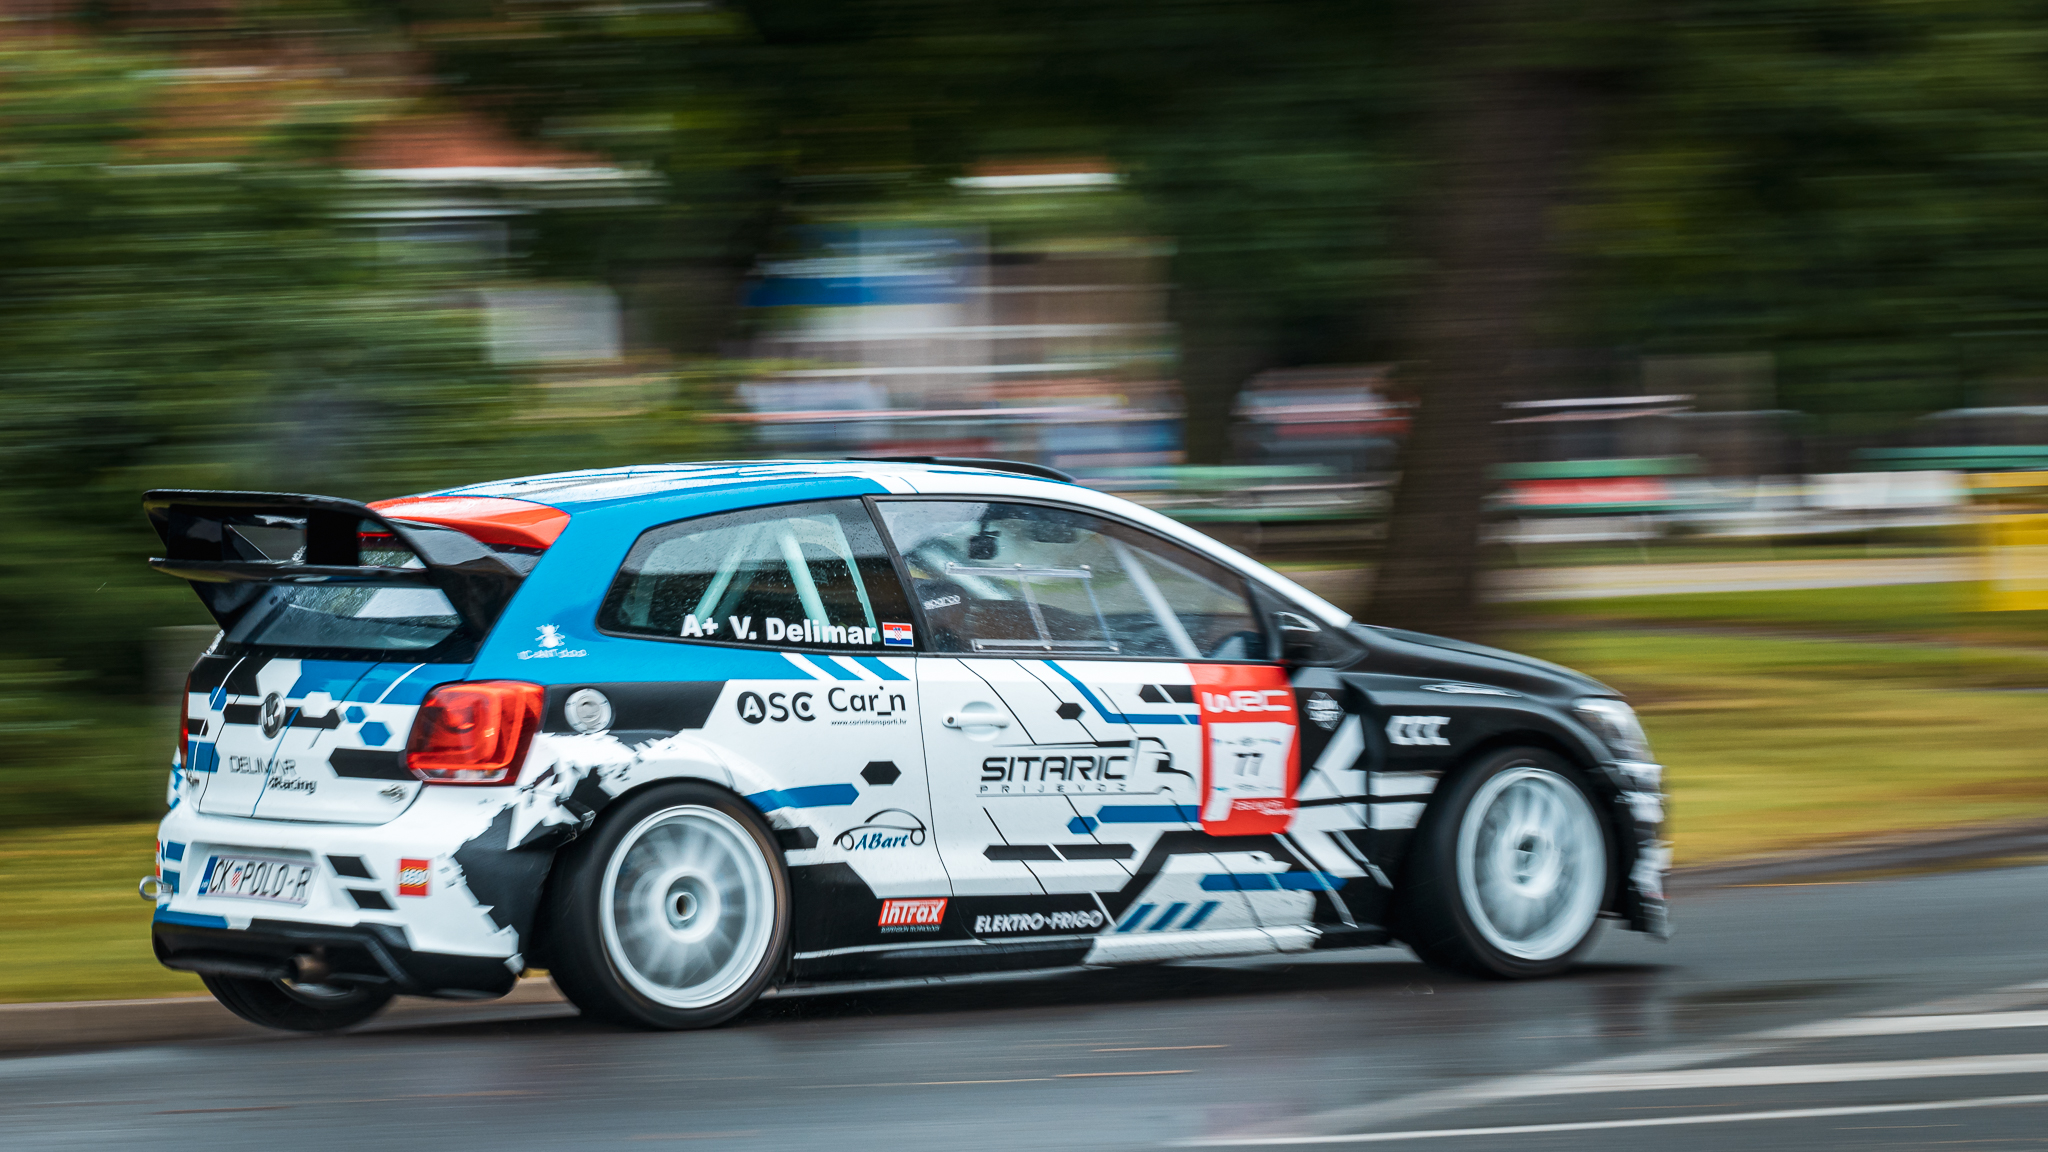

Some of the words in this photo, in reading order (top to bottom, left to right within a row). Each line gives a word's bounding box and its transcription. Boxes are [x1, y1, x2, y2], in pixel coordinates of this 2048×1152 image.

[680, 613, 719, 638] A+
[728, 615, 757, 640] V.
[766, 616, 876, 645] Delimar
[736, 690, 817, 725] ASC
[228, 754, 297, 777] DELIMAR
[1231, 752, 1265, 777] 77
[979, 783, 1128, 794] PRIJEVOZ
[854, 832, 910, 851] ABart
[208, 858, 236, 894] CK
